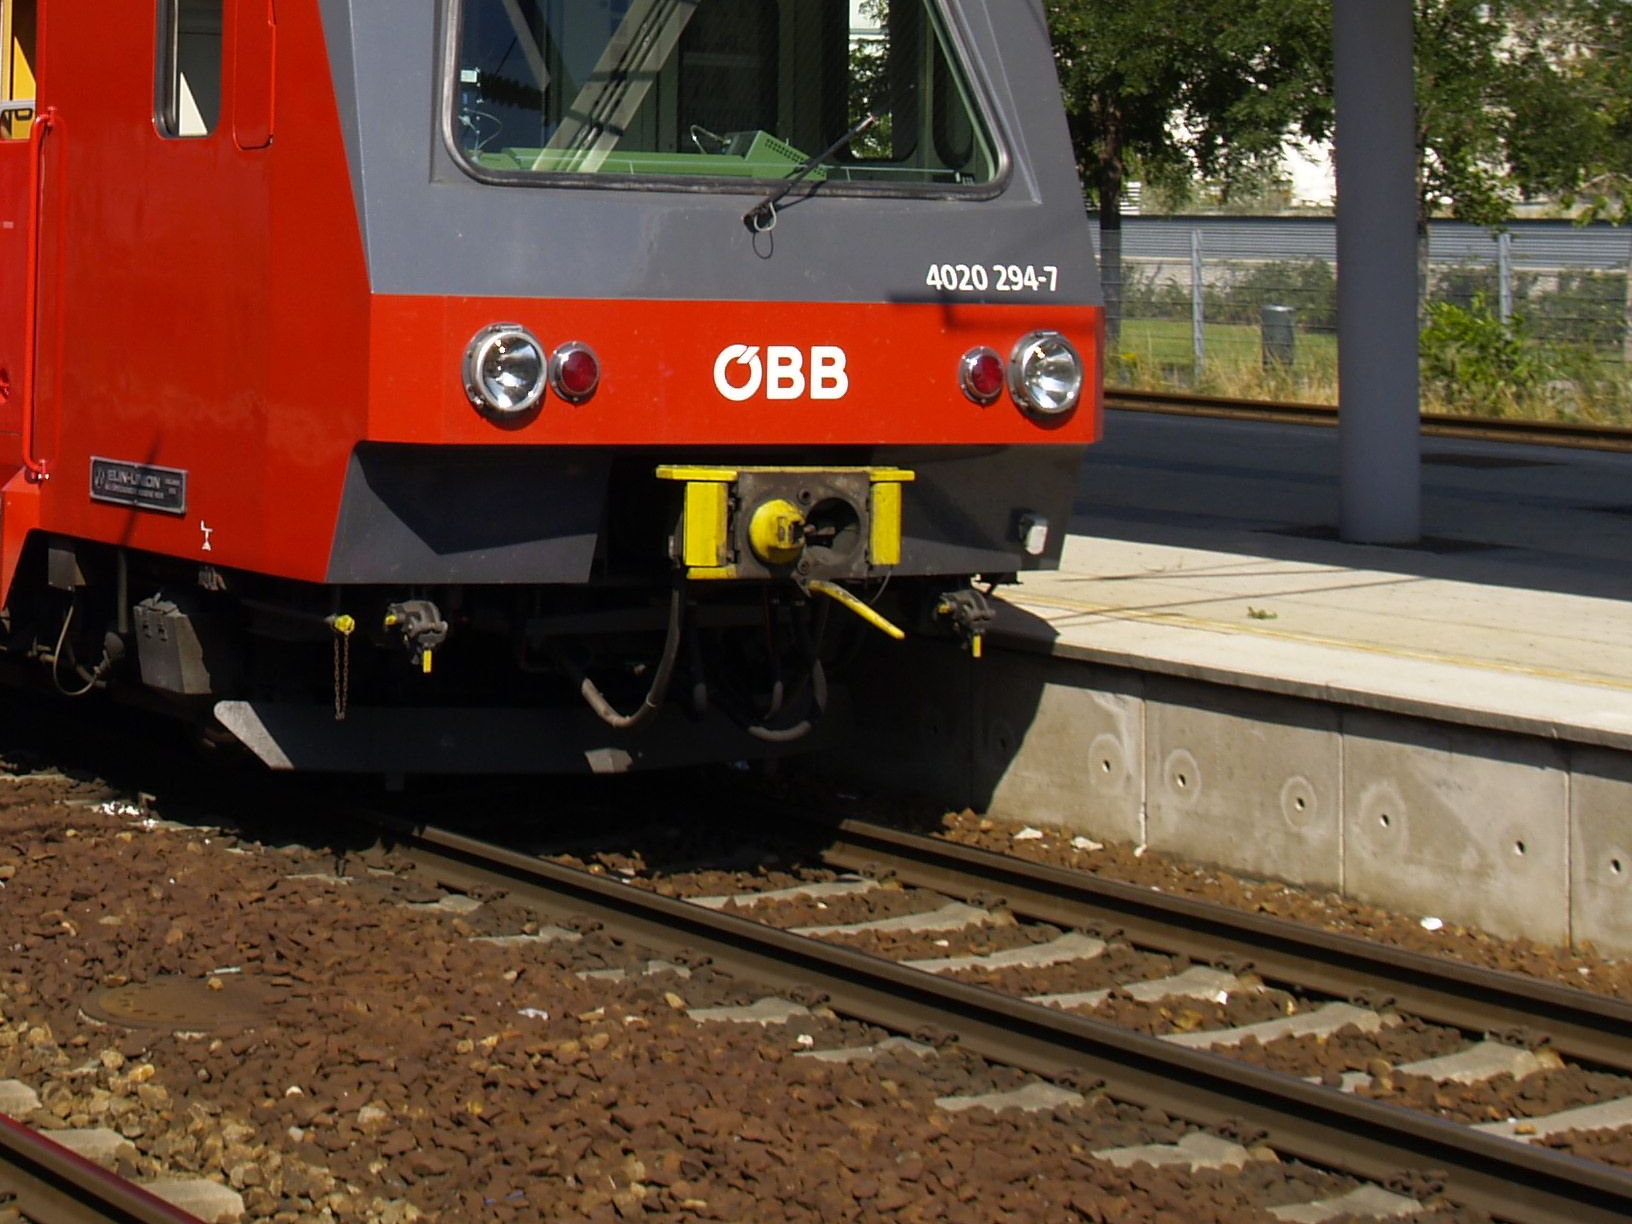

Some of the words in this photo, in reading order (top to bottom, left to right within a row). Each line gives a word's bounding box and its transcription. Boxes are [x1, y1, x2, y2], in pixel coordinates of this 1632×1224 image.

[925, 263, 989, 291] 4020
[992, 264, 1058, 292] 294-7
[713, 343, 850, 402] ÖBB
